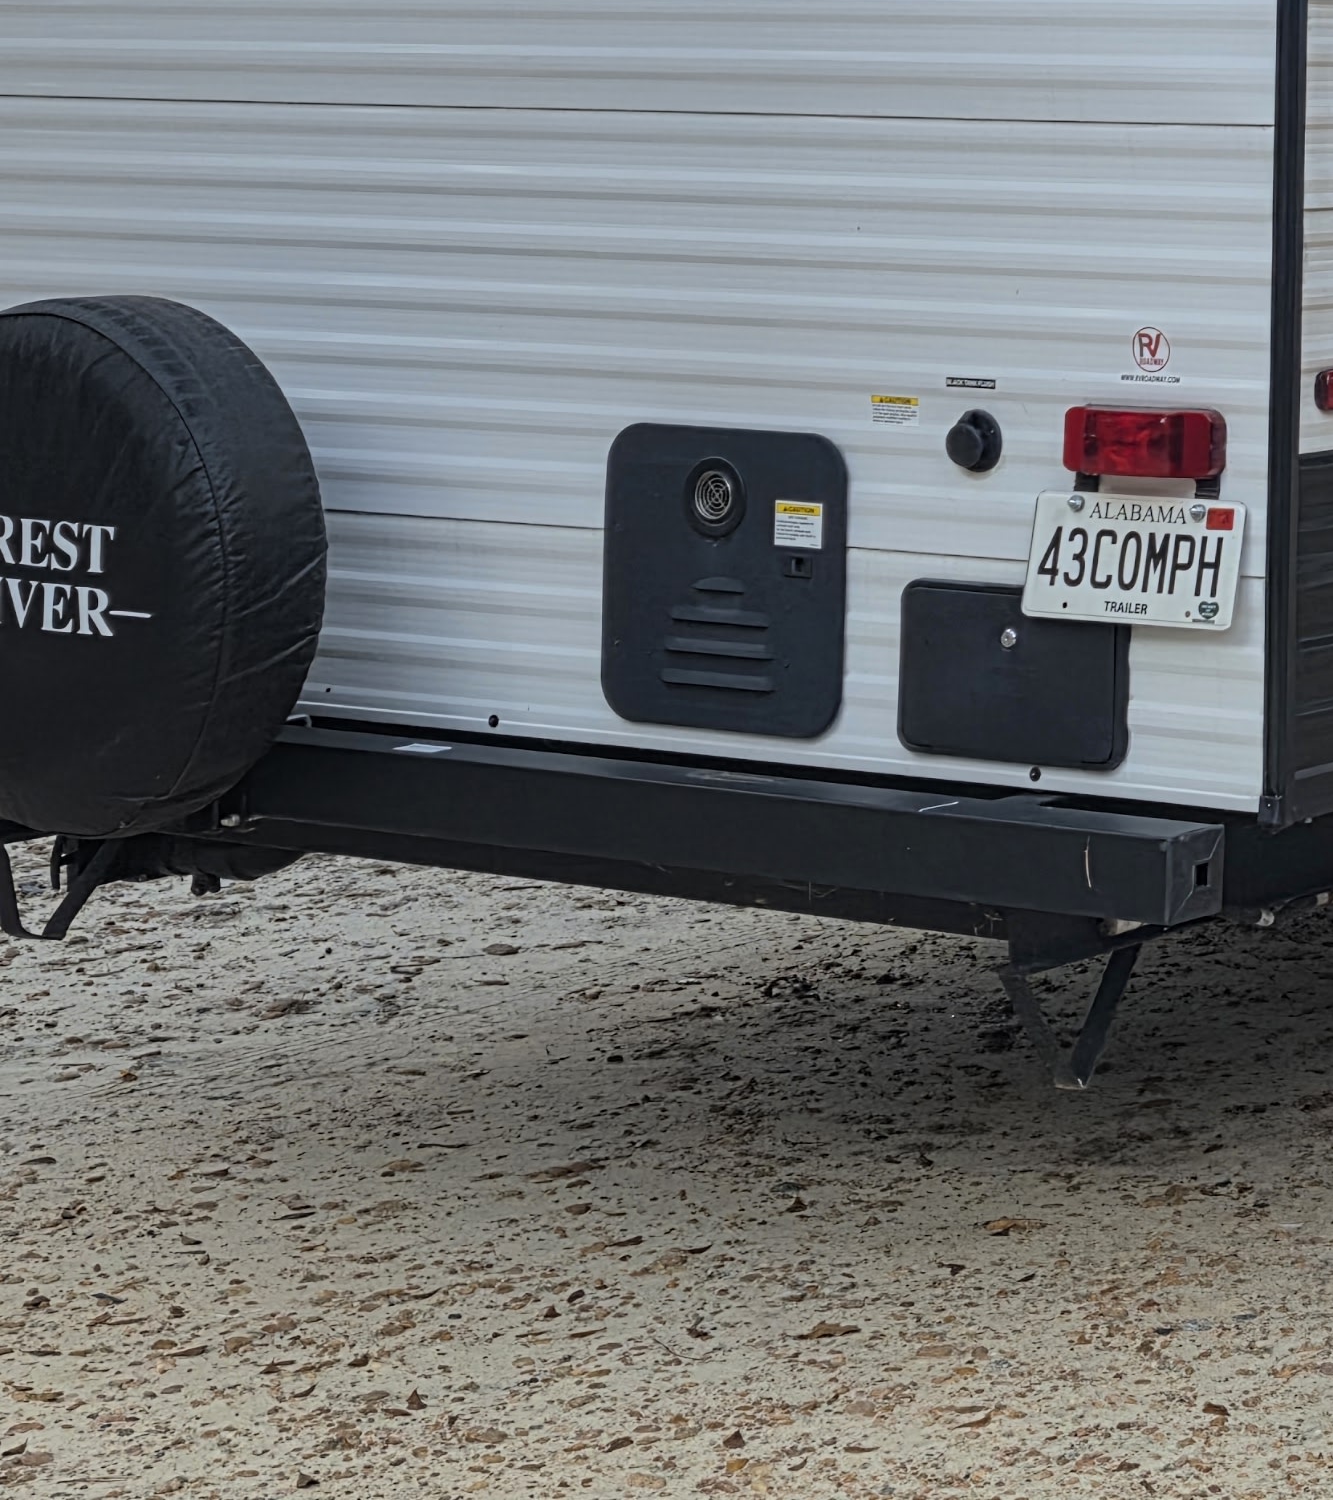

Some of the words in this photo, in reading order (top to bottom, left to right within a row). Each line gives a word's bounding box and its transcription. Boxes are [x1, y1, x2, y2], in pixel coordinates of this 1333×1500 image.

[1138, 333, 1162, 358] RV
[1139, 357, 1164, 366] ROADWAY
[1089, 502, 1187, 524] ALABAMA
[0, 576, 114, 637] VER
[1104, 601, 1148, 615] TRAILER
